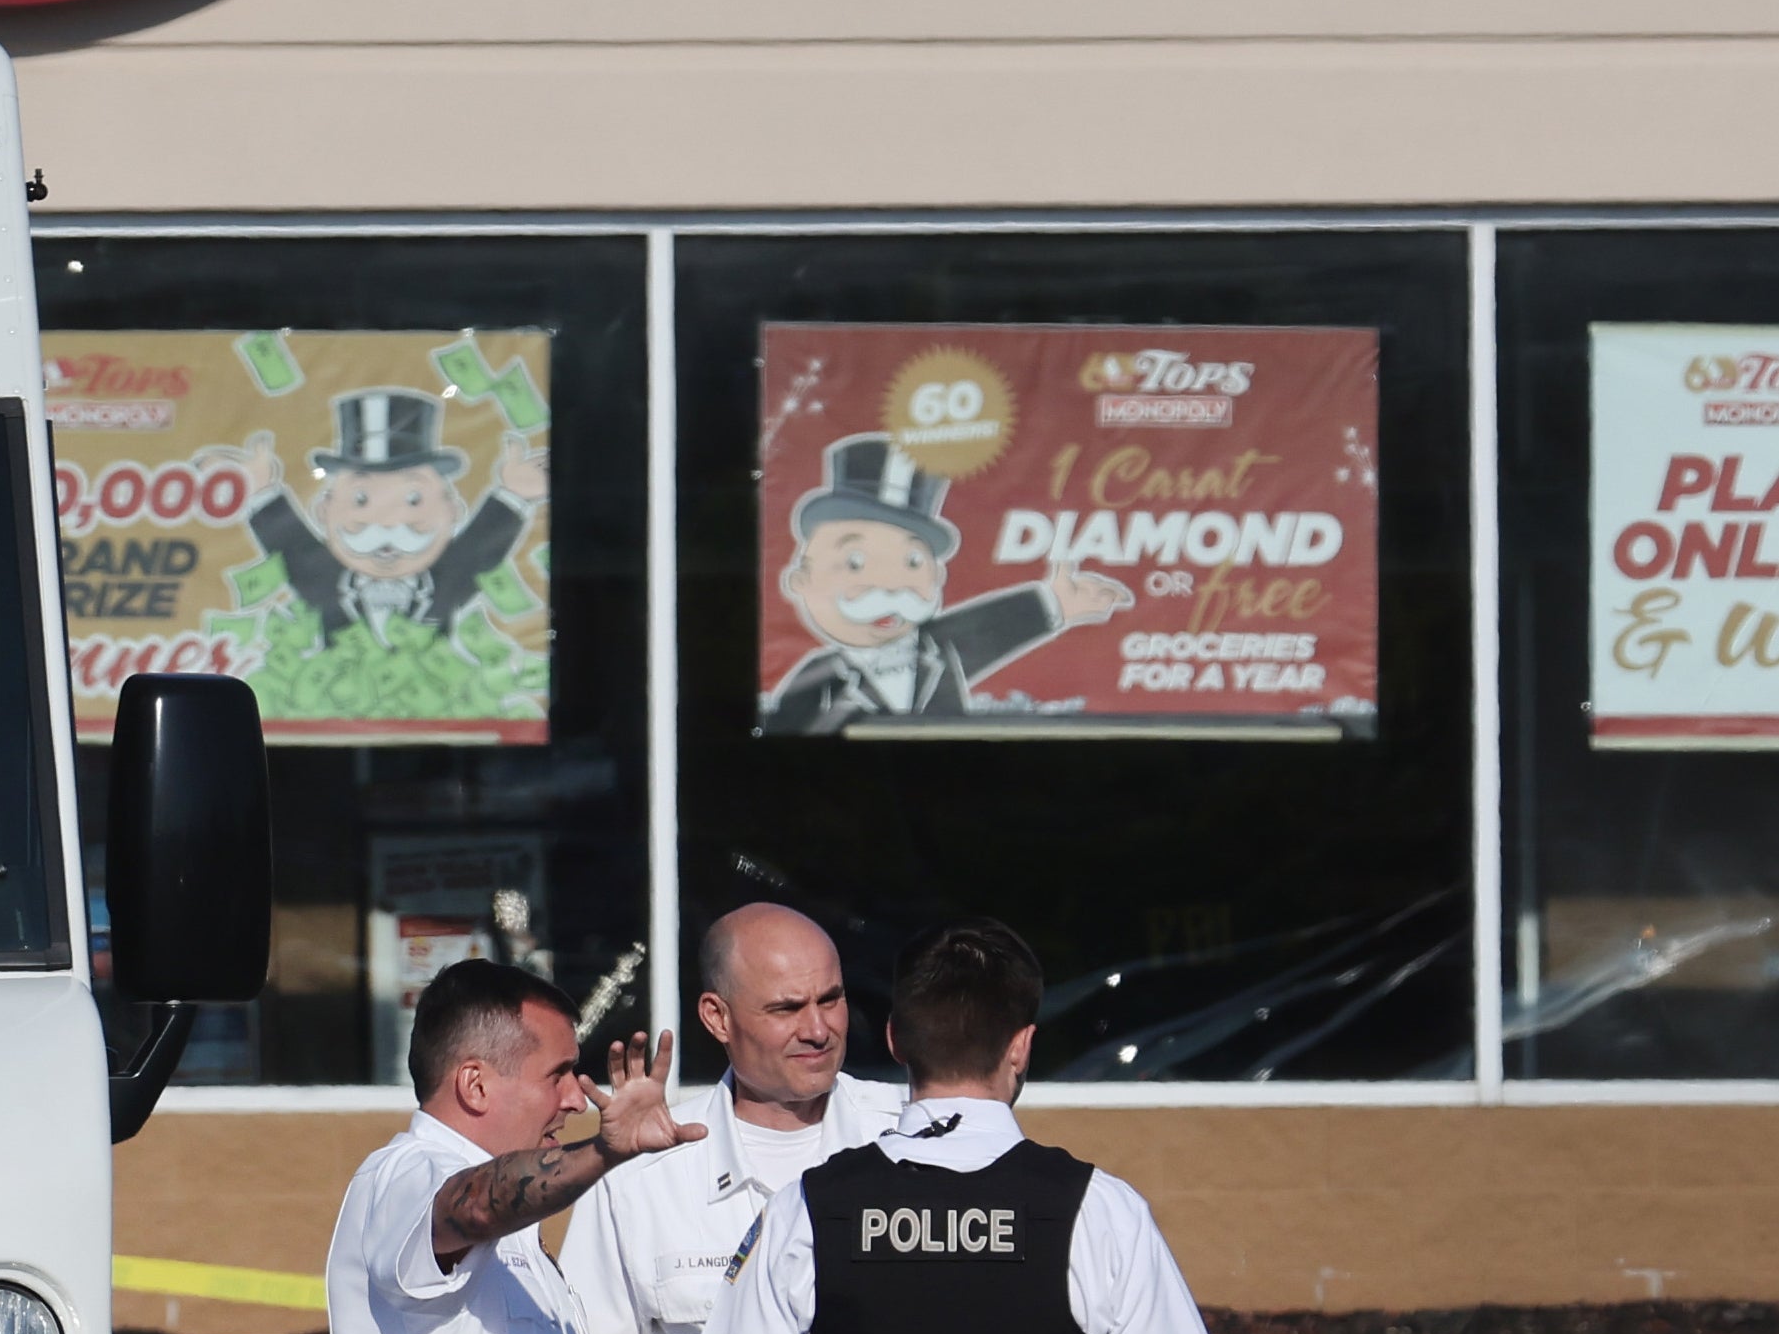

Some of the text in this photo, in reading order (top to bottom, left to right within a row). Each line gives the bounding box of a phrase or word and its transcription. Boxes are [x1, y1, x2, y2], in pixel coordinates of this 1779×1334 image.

[909, 379, 985, 425] 60
[1105, 398, 1229, 422] MONOPOLY
[1050, 443, 1284, 509] 1 Carat
[994, 509, 1342, 565] DIAMOND
[1145, 553, 1332, 634] OR free
[1120, 631, 1319, 661] GROCERIES
[1613, 587, 1692, 679] &
[1118, 662, 1327, 692] FOR A YEAR
[861, 1207, 1016, 1253] POLICE
[674, 1258, 685, 1269] J.
